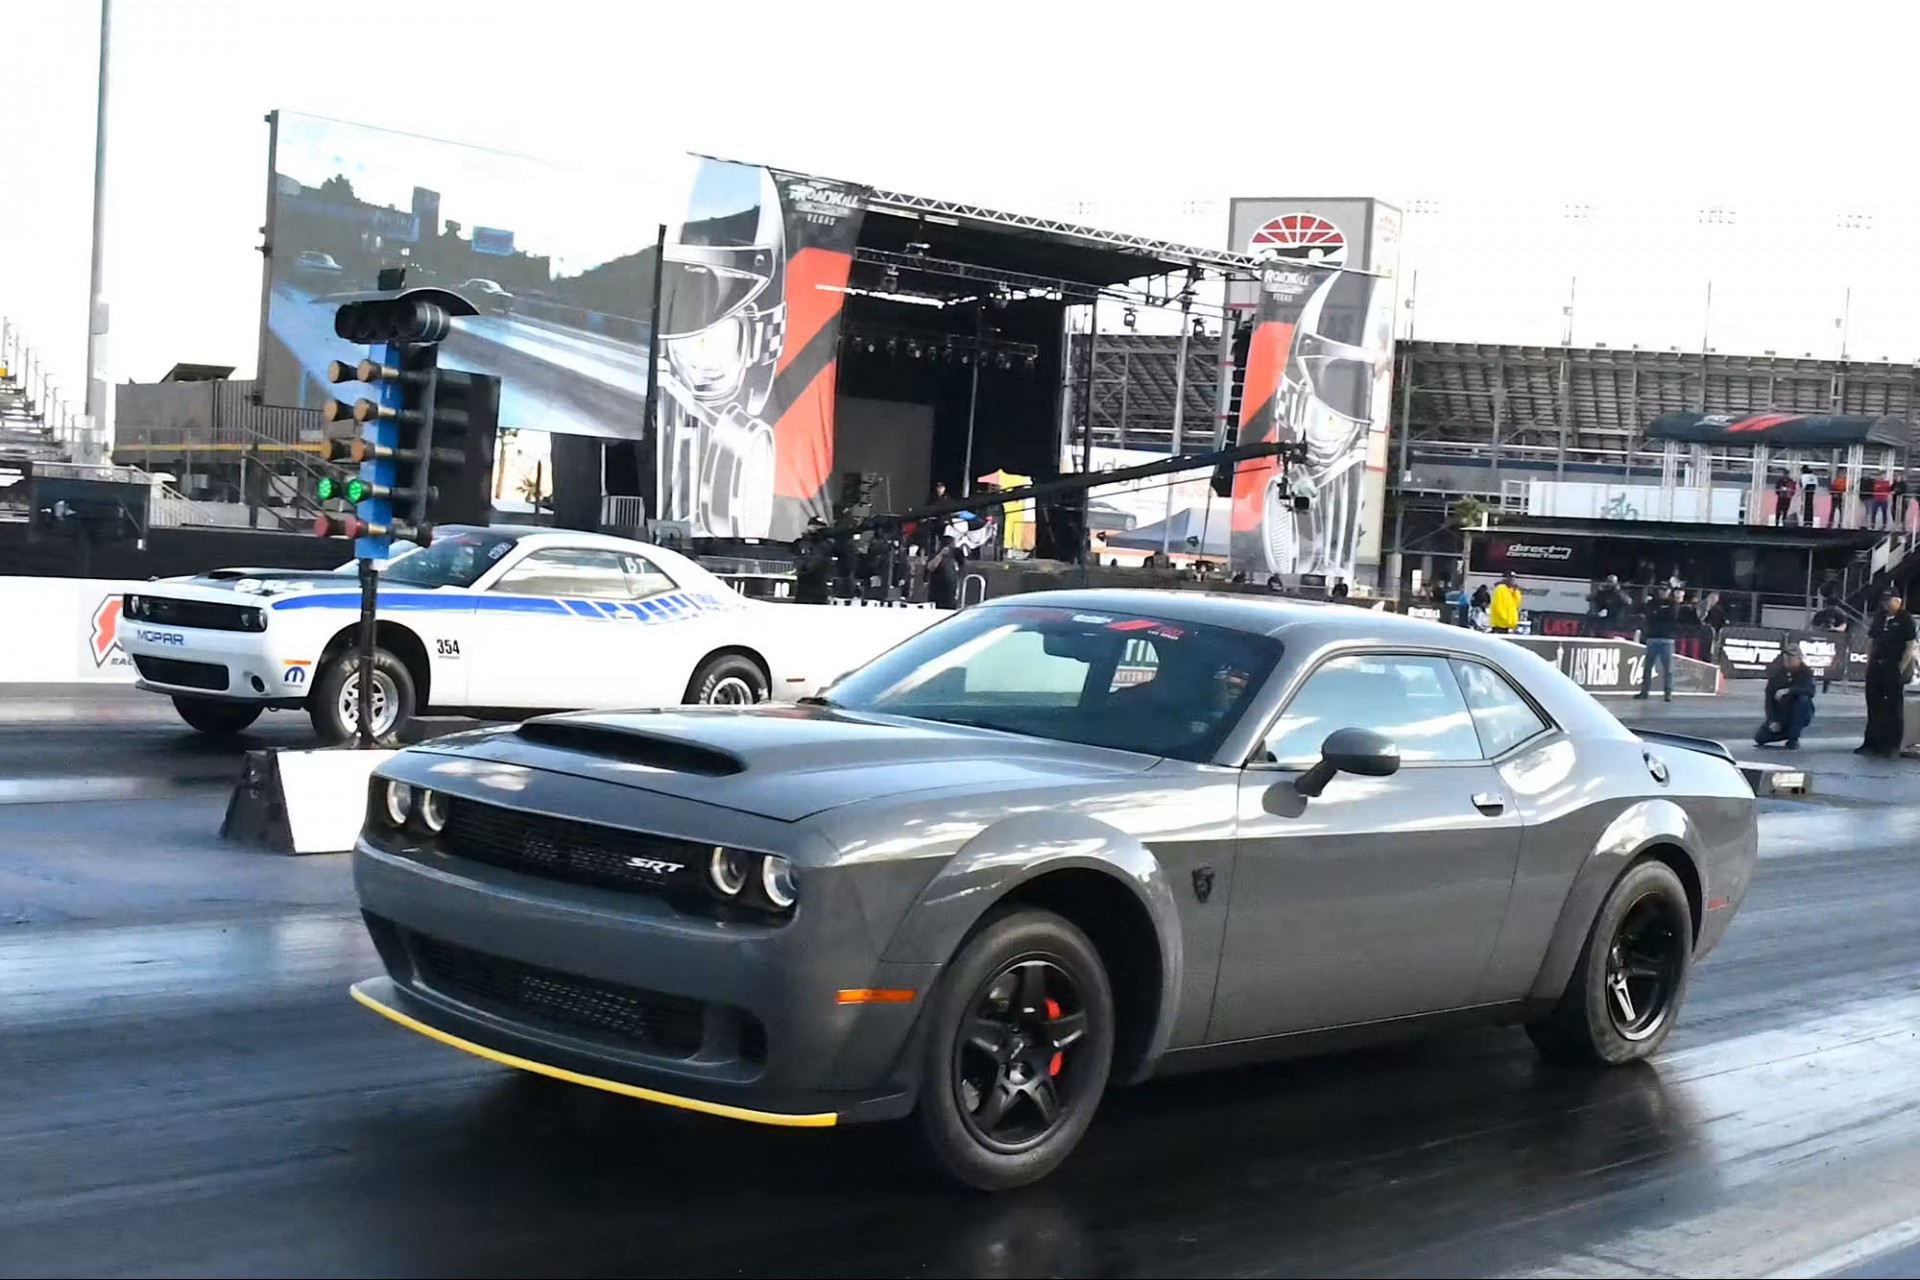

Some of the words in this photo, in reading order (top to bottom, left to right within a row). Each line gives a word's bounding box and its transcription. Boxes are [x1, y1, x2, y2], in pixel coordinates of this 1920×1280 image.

[137, 629, 184, 646] MOPAR
[436, 638, 460, 655] 354
[1569, 647, 1588, 685] LAS
[1586, 647, 1621, 686] VEGAS
[625, 857, 685, 875] SRT
